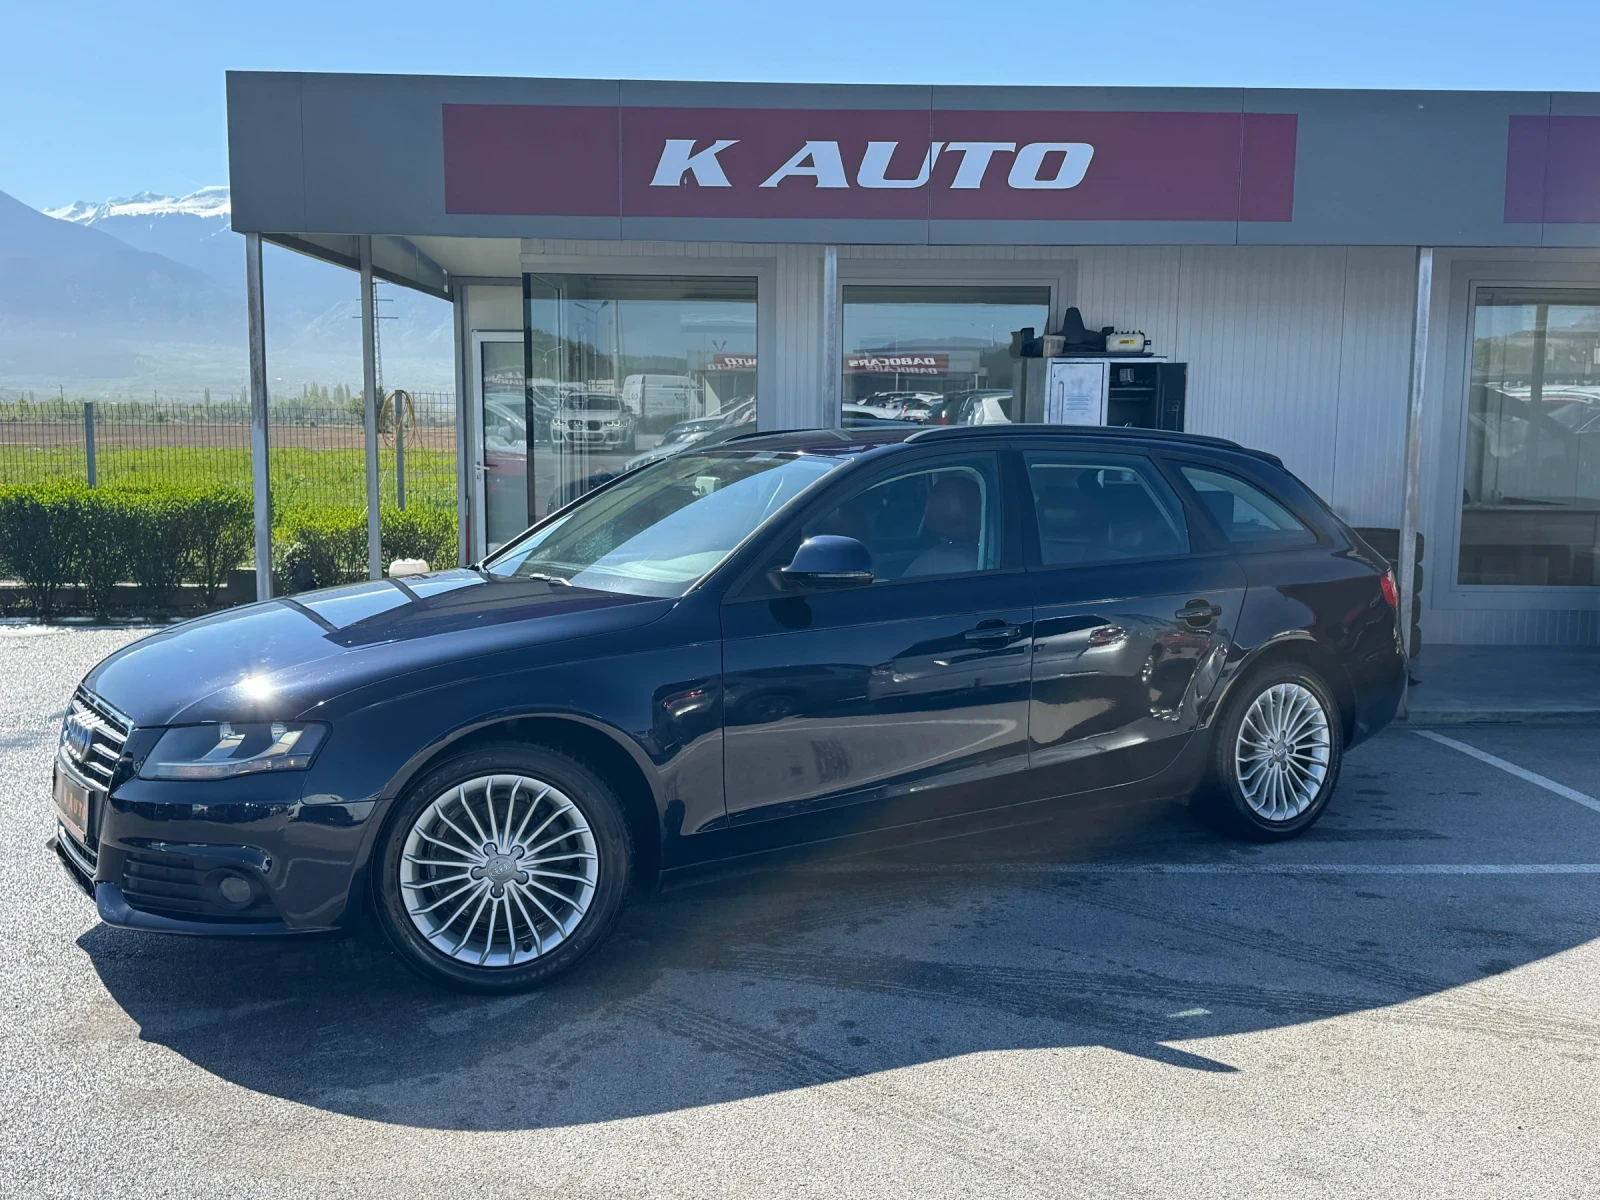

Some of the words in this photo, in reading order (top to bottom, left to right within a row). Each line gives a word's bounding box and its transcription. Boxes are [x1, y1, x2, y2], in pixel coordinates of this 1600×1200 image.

[649, 138, 741, 188] K
[758, 140, 1096, 190] AUTO
[69, 792, 87, 821] AUTO
